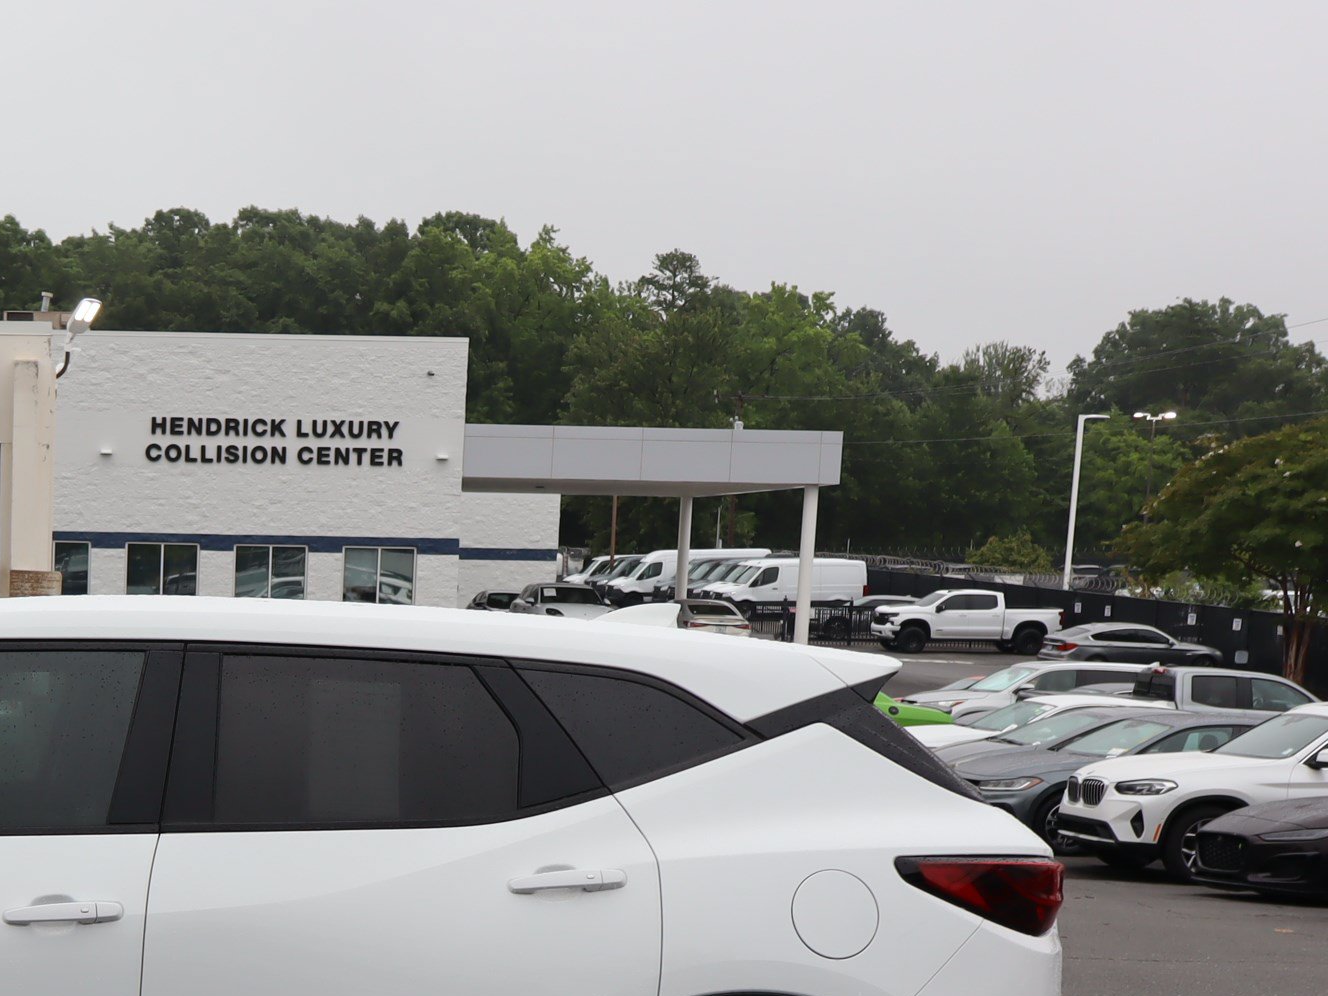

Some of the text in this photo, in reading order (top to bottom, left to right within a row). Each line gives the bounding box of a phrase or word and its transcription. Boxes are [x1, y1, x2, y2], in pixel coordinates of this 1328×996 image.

[150, 416, 400, 440] HENDRICK LUXURY
[145, 443, 403, 467] COLLISION CENTER
